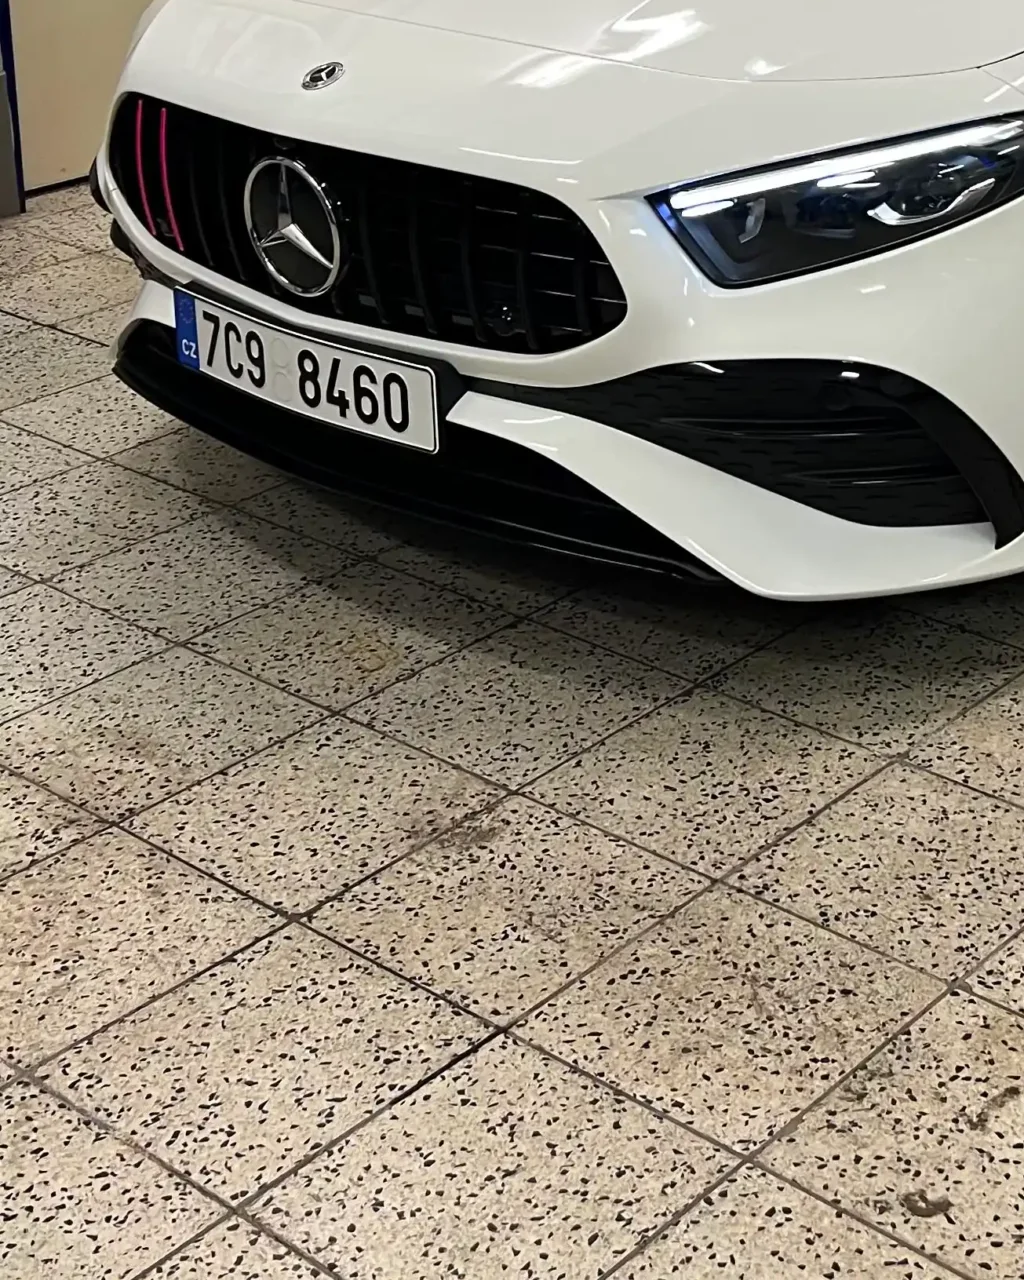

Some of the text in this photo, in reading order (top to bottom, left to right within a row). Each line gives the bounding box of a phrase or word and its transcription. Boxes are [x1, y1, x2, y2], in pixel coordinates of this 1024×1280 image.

[182, 339, 197, 358] CZ
[202, 310, 410, 433] 7C9 8460
